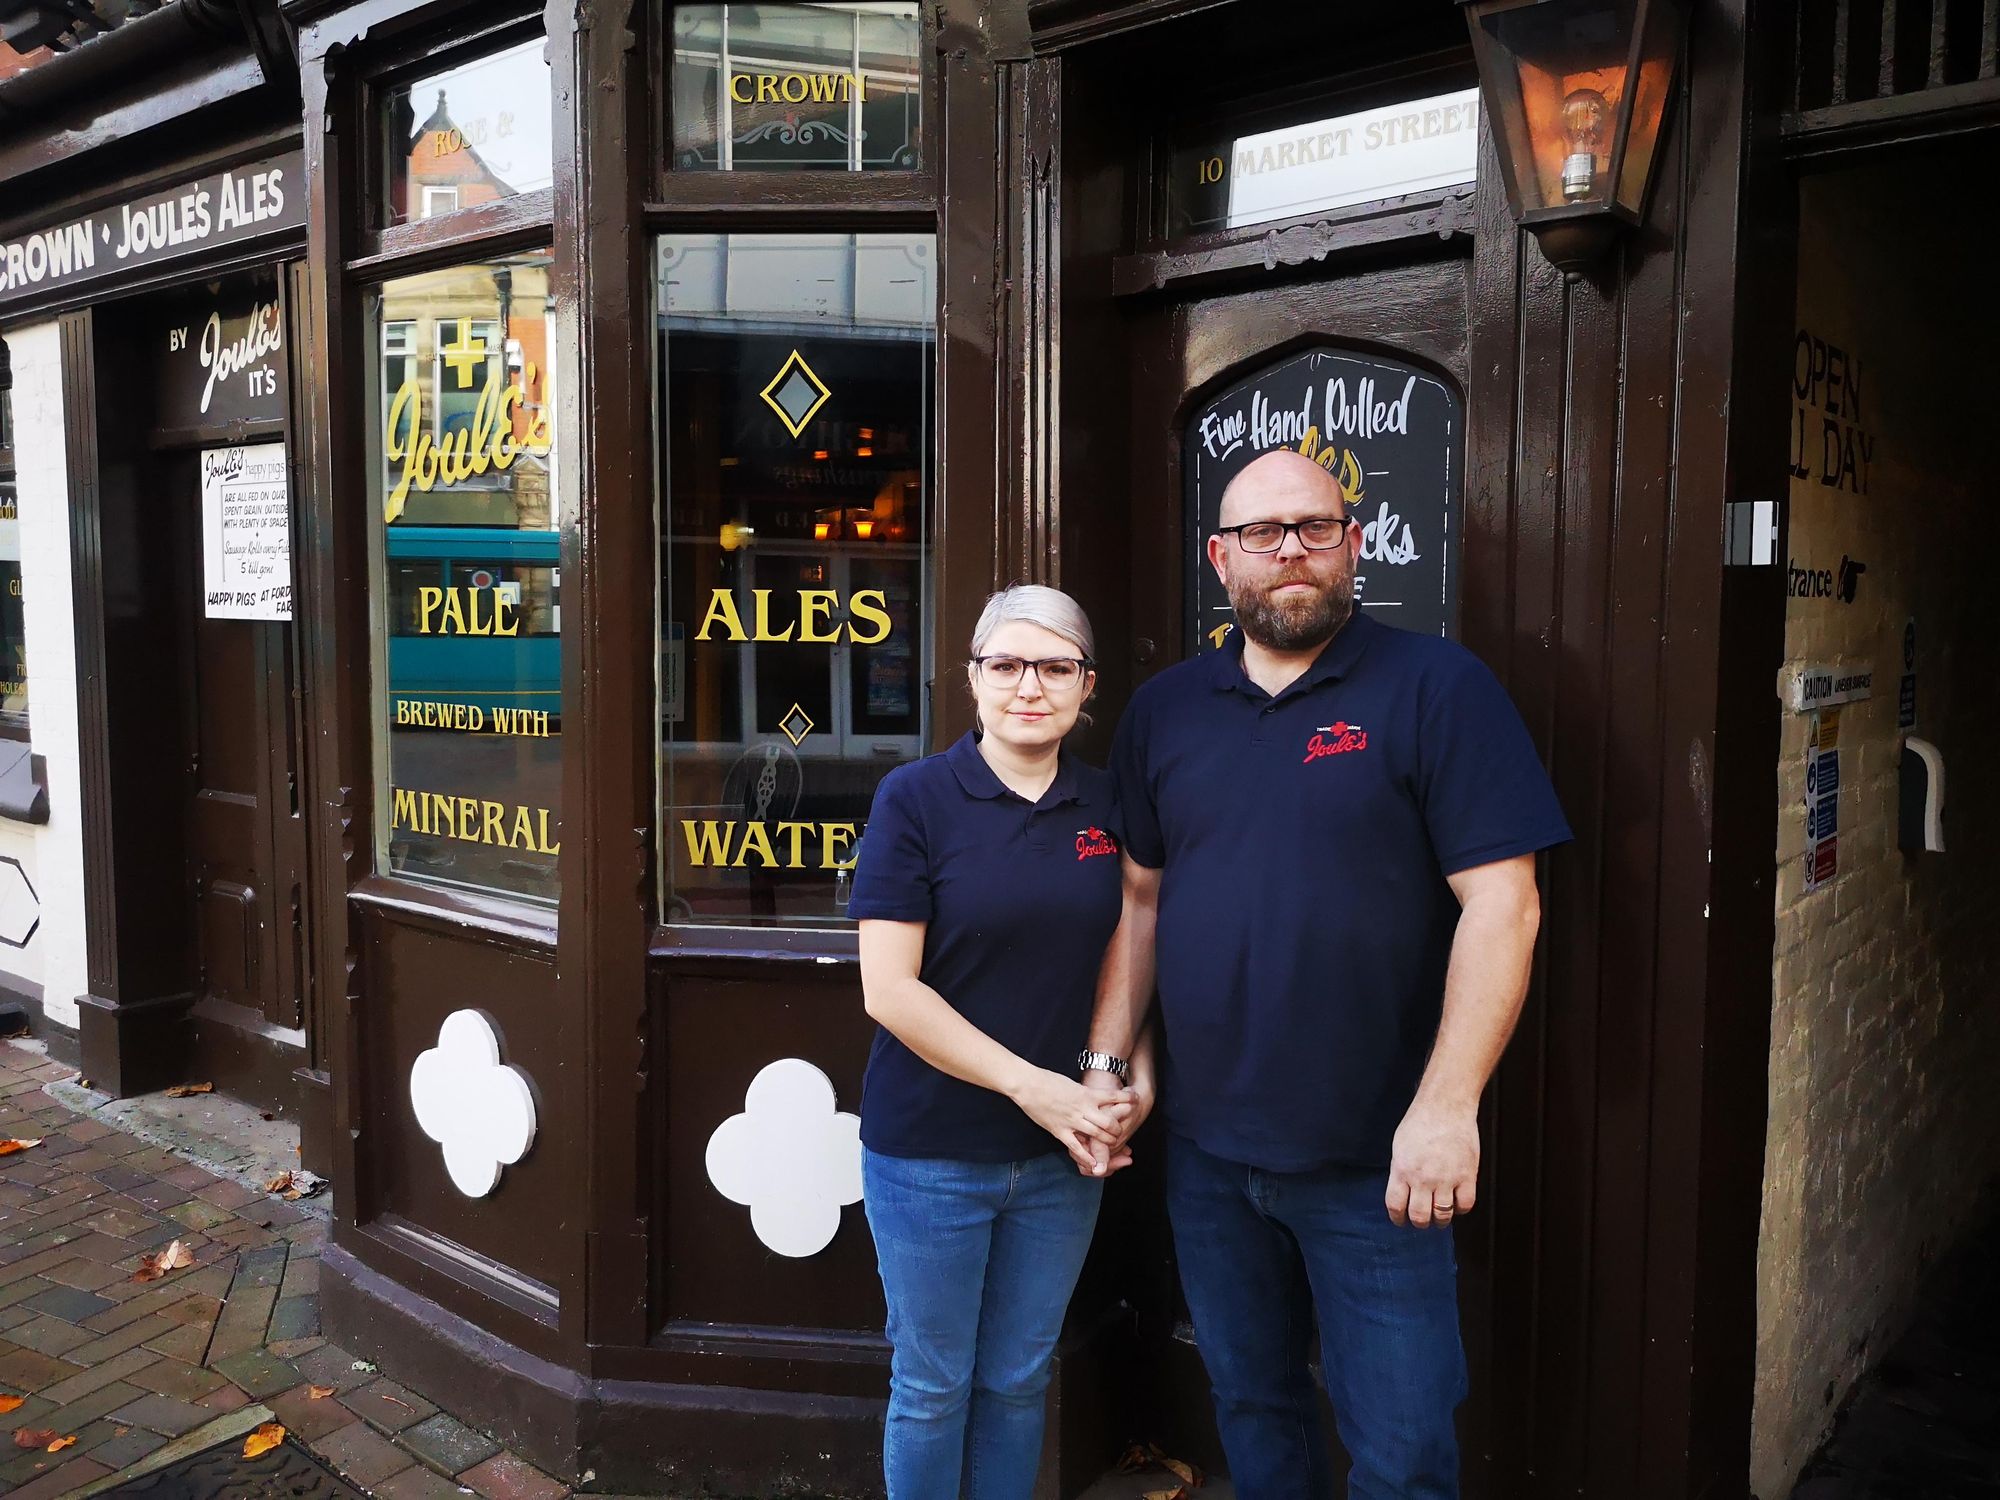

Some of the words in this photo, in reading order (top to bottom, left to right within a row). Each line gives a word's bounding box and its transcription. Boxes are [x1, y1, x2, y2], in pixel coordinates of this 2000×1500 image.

[730, 73, 868, 103] CROWN
[434, 118, 488, 158] ROSE
[497, 111, 514, 138] &
[1200, 157, 1223, 184] 10
[1234, 128, 1352, 178] MARKET
[1364, 100, 1478, 150] STREET
[116, 183, 211, 258] JOULE'S
[218, 169, 284, 232] ALES
[170, 327, 188, 351] BY
[249, 364, 276, 397] IT'S
[1793, 329, 1862, 423] OPEN
[1199, 409, 1246, 458] Fine
[1250, 385, 1312, 450] Hand
[1325, 375, 1416, 441] Pulled
[245, 459, 267, 480] happy
[268, 459, 284, 480] pigs
[1822, 417, 1874, 495] DAY
[225, 493, 235, 502] ARE
[238, 492, 247, 501] ALL
[248, 491, 258, 501] FED
[261, 491, 269, 500] ON
[271, 490, 285, 500] OUR
[225, 506, 242, 516] SPENT
[244, 505, 261, 515] GRAIN
[265, 504, 288, 514] OUTSIDE
[224, 519, 237, 528] WITH
[240, 518, 259, 528] PLENTY
[261, 518, 267, 527] OF
[269, 517, 288, 527] SPACE
[1360, 502, 1421, 566] cks
[225, 540, 247, 560] Sausage
[248, 541, 261, 555] Rolls
[241, 562, 246, 573] 5
[208, 592, 234, 606] HAPPY
[236, 592, 257, 606] PIGS
[261, 589, 269, 602] AT
[271, 585, 291, 600] FORD
[1787, 558, 1832, 598] trance
[276, 601, 292, 614] FAR
[419, 586, 519, 636] PALE
[694, 588, 892, 644] ALES
[1805, 675, 1832, 701] CAUTION
[397, 699, 484, 731] BREWED
[492, 707, 549, 737] WITH
[392, 788, 560, 856] MINERAL
[681, 819, 866, 869] WATE
